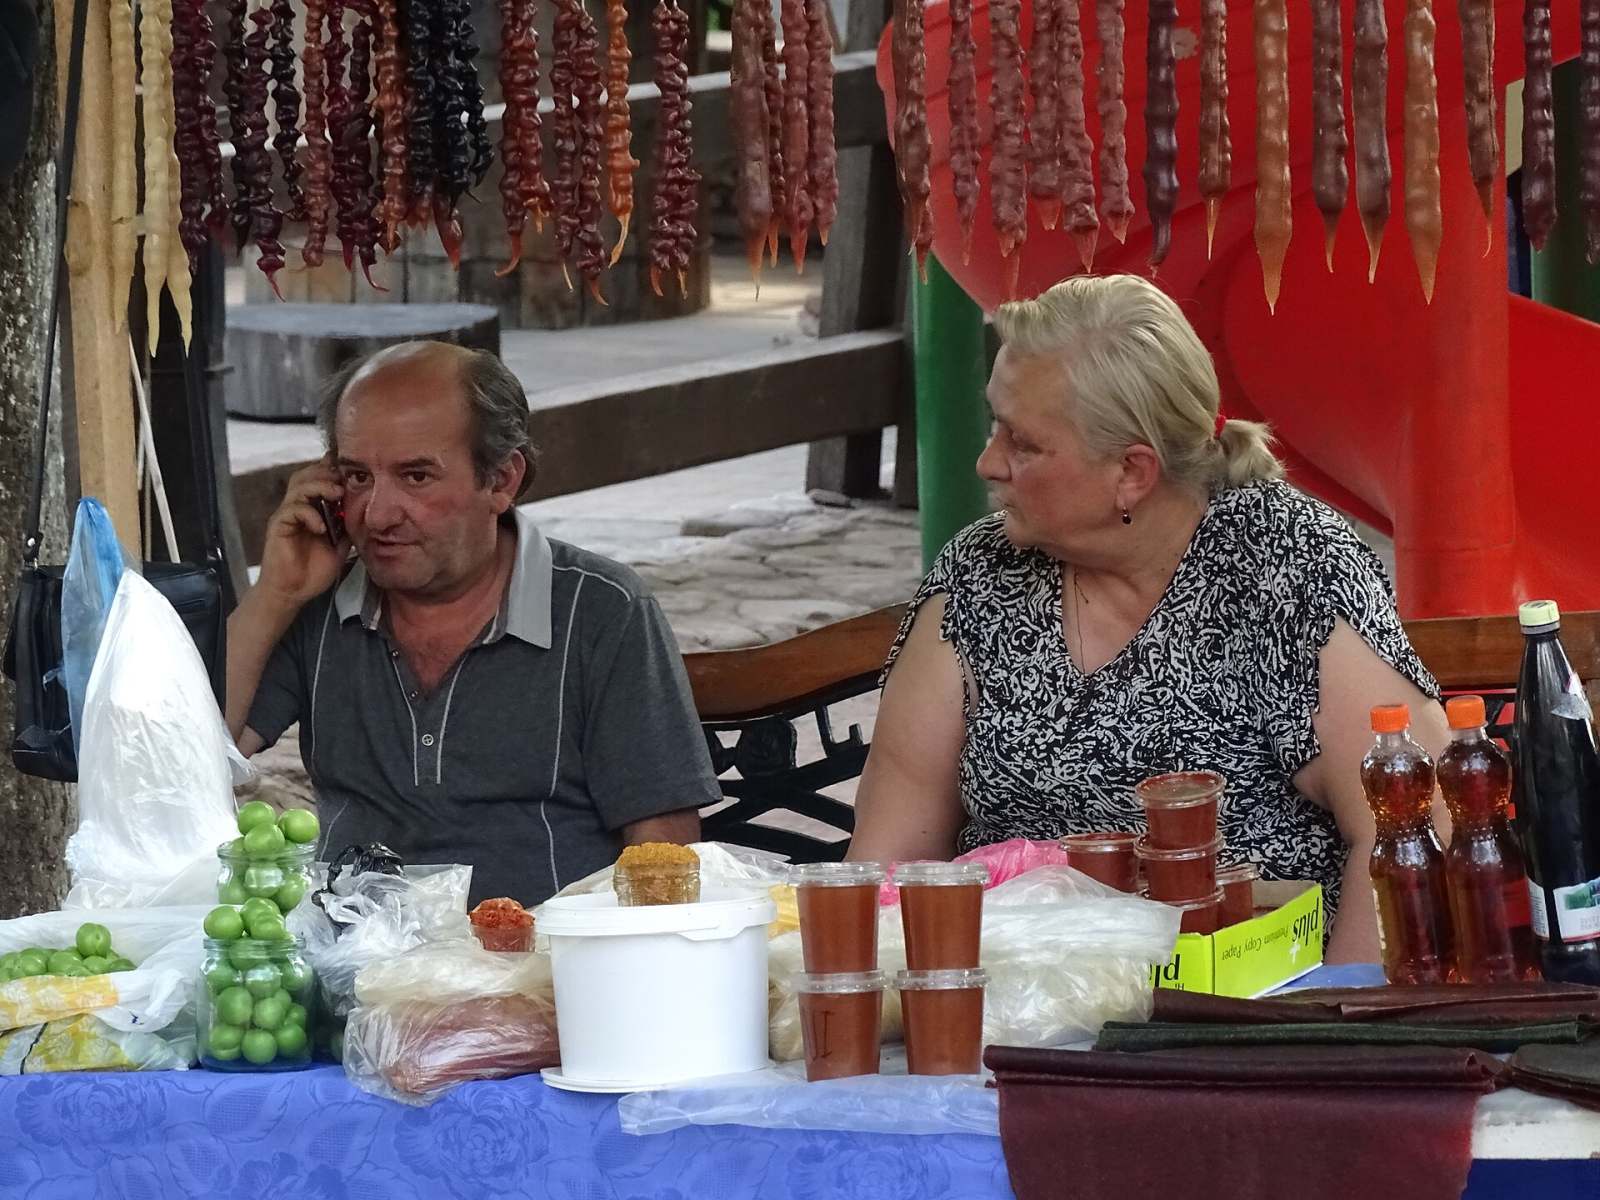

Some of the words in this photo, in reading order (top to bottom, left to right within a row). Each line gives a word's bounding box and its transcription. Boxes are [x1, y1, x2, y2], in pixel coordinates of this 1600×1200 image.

[1292, 897, 1319, 947] plus
[1221, 945, 1242, 960] Paper
[1243, 937, 1262, 953] Copy
